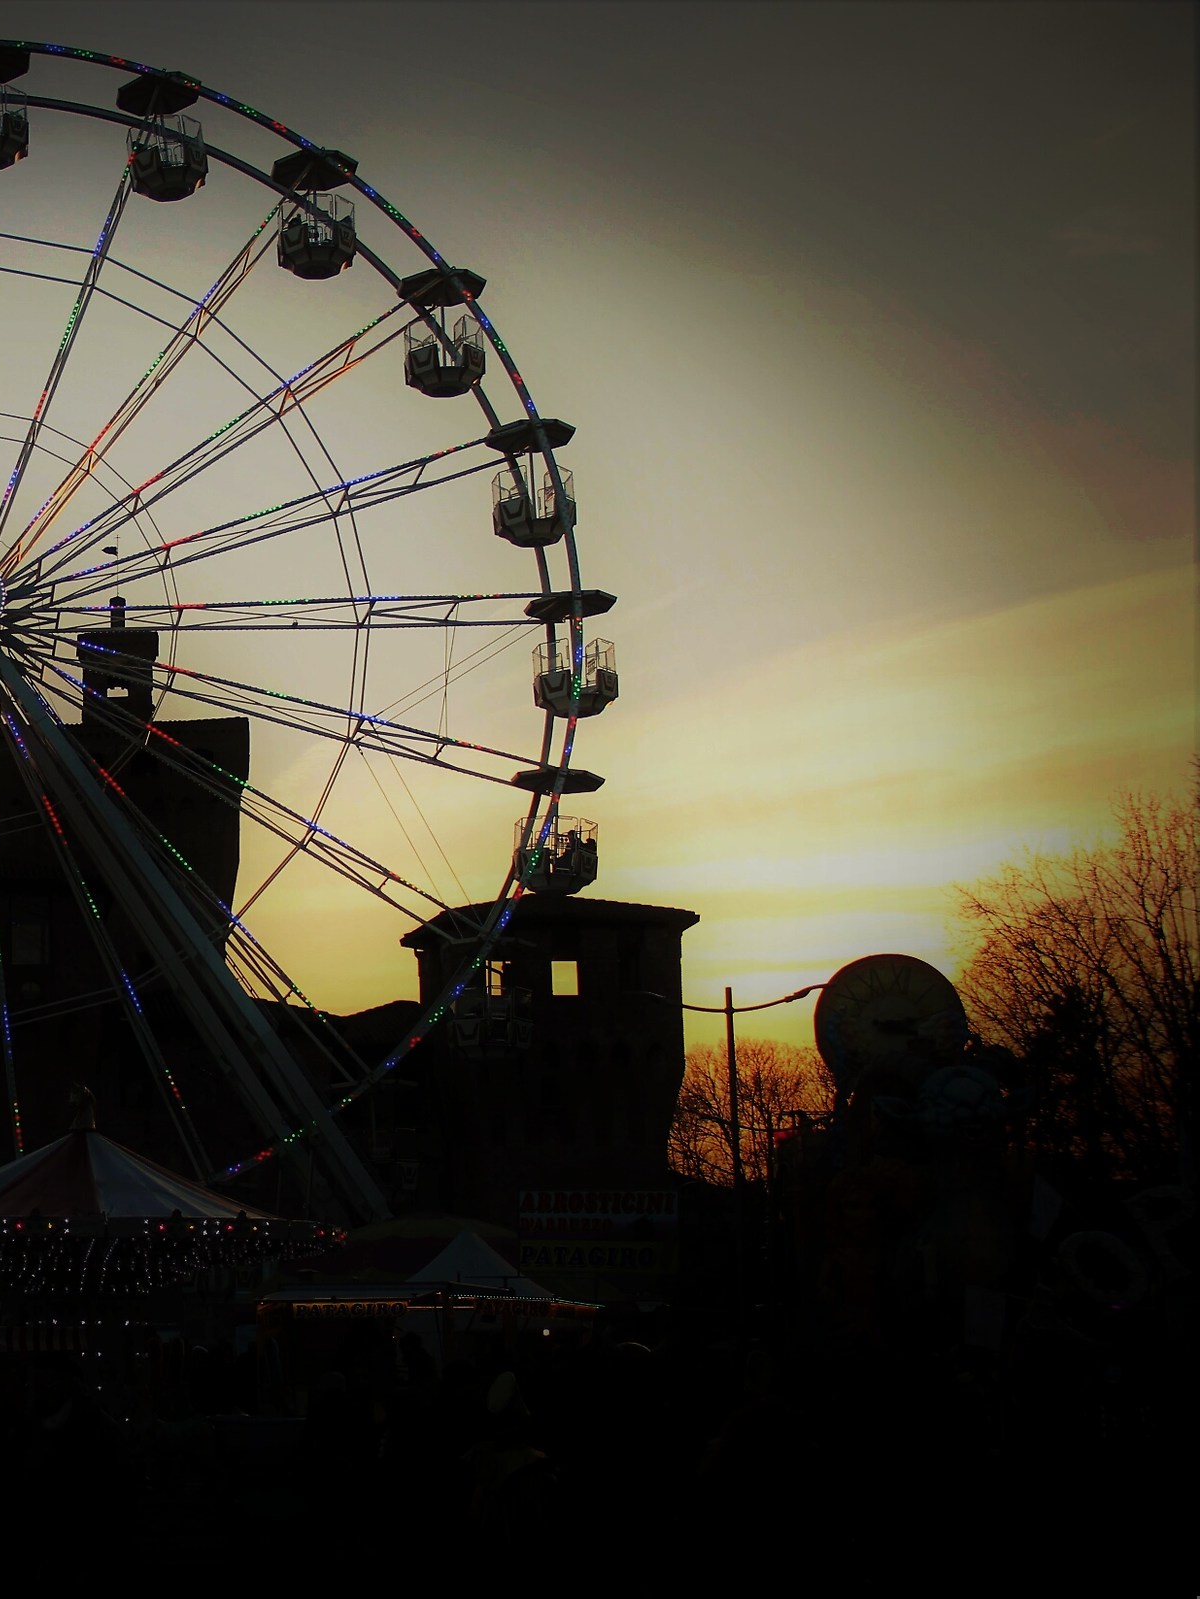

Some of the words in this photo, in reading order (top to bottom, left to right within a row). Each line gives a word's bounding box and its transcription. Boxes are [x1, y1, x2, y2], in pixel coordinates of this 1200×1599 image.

[520, 1191, 674, 1213] ARROSTICINI
[521, 1246, 656, 1268] PATAGIRO
[295, 1302, 408, 1318] PATAGIRO
